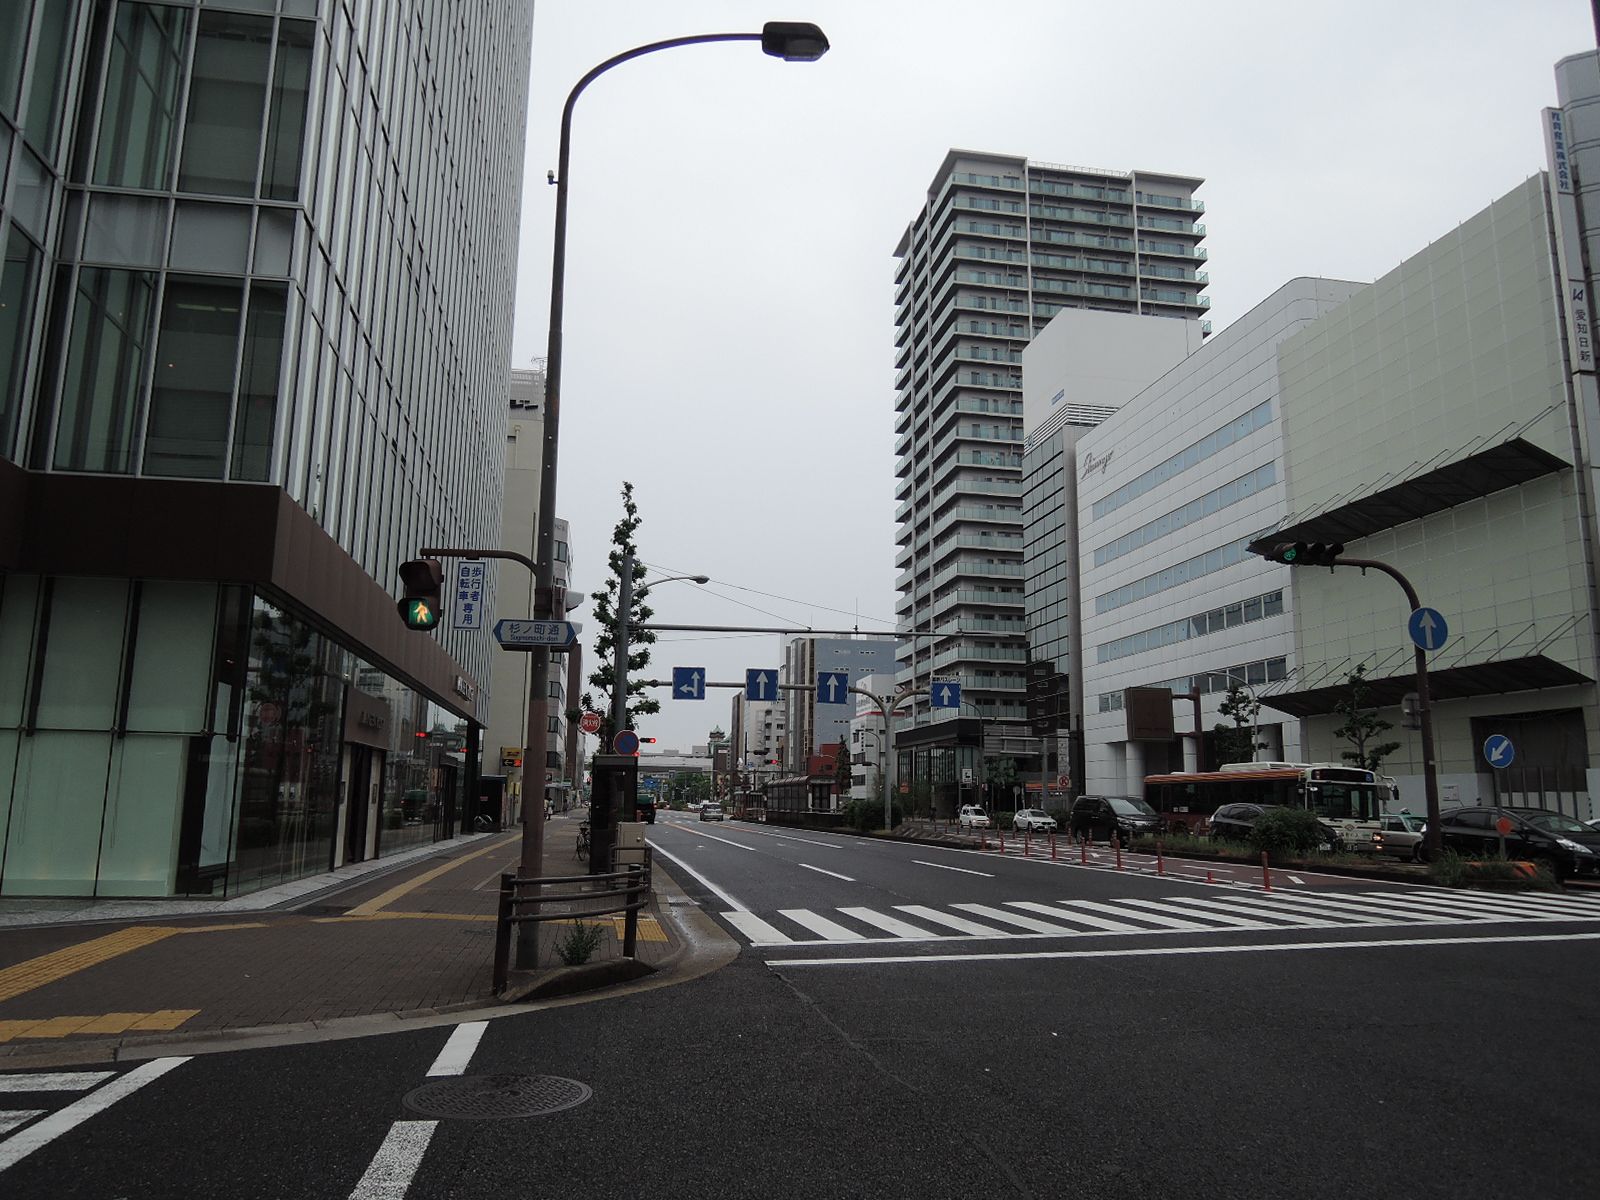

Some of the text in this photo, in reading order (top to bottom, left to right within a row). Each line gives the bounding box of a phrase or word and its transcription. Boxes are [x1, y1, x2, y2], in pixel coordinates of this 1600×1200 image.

[1574, 309, 1591, 362] 愛知日新
[458, 566, 471, 601] 自転車
[469, 565, 483, 602] 歩行者
[462, 603, 475, 625] 専用
[508, 622, 560, 635] 杉ノ町通
